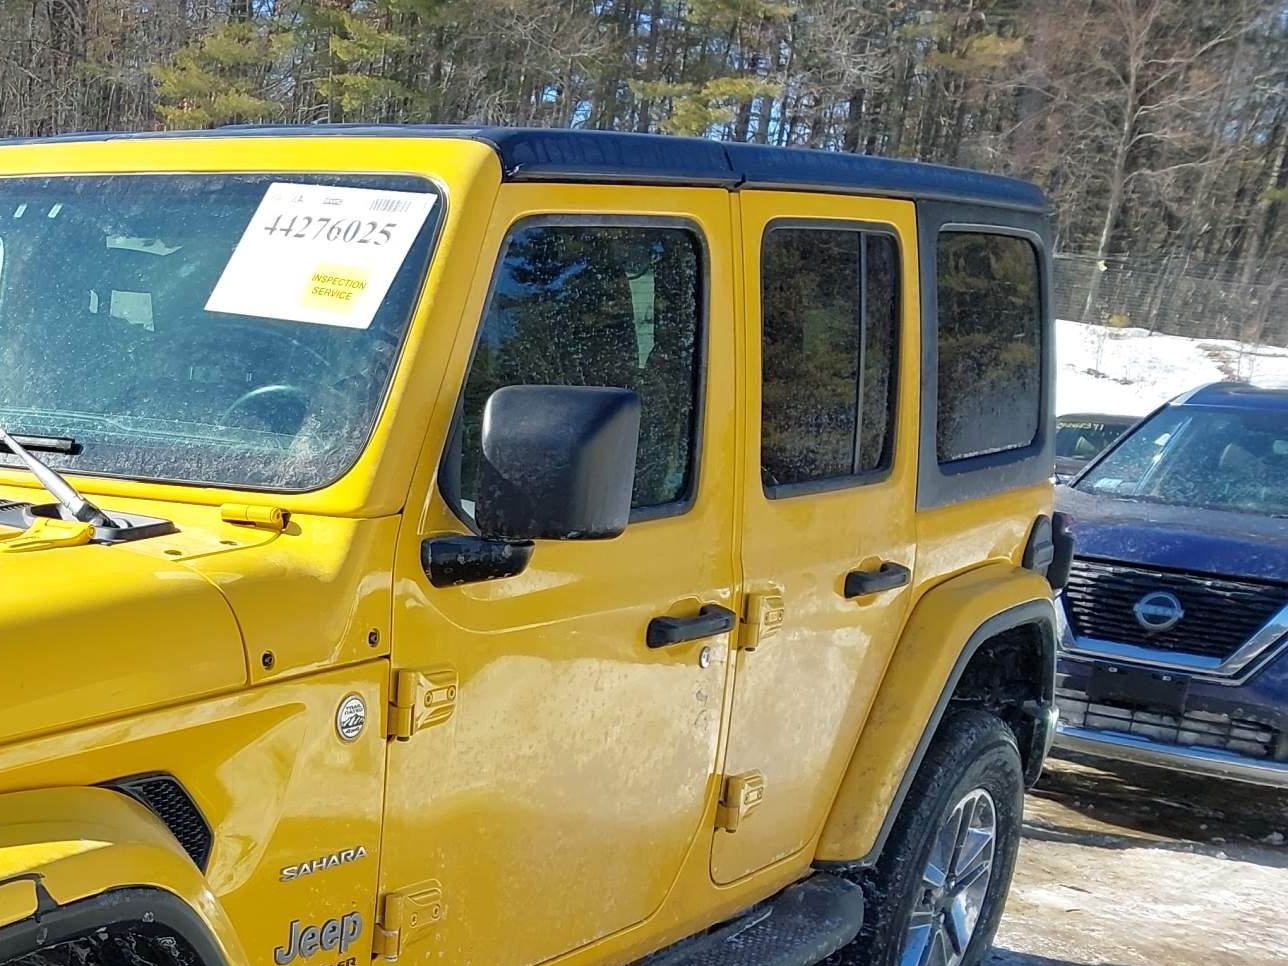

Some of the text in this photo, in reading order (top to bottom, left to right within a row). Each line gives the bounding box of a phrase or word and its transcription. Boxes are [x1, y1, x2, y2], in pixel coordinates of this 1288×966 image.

[264, 214, 398, 246] 44276025
[311, 286, 353, 301] SERVICE
[312, 273, 368, 290] INSPECTION
[279, 846, 368, 882] SAHARA
[274, 911, 363, 966] Jeep
